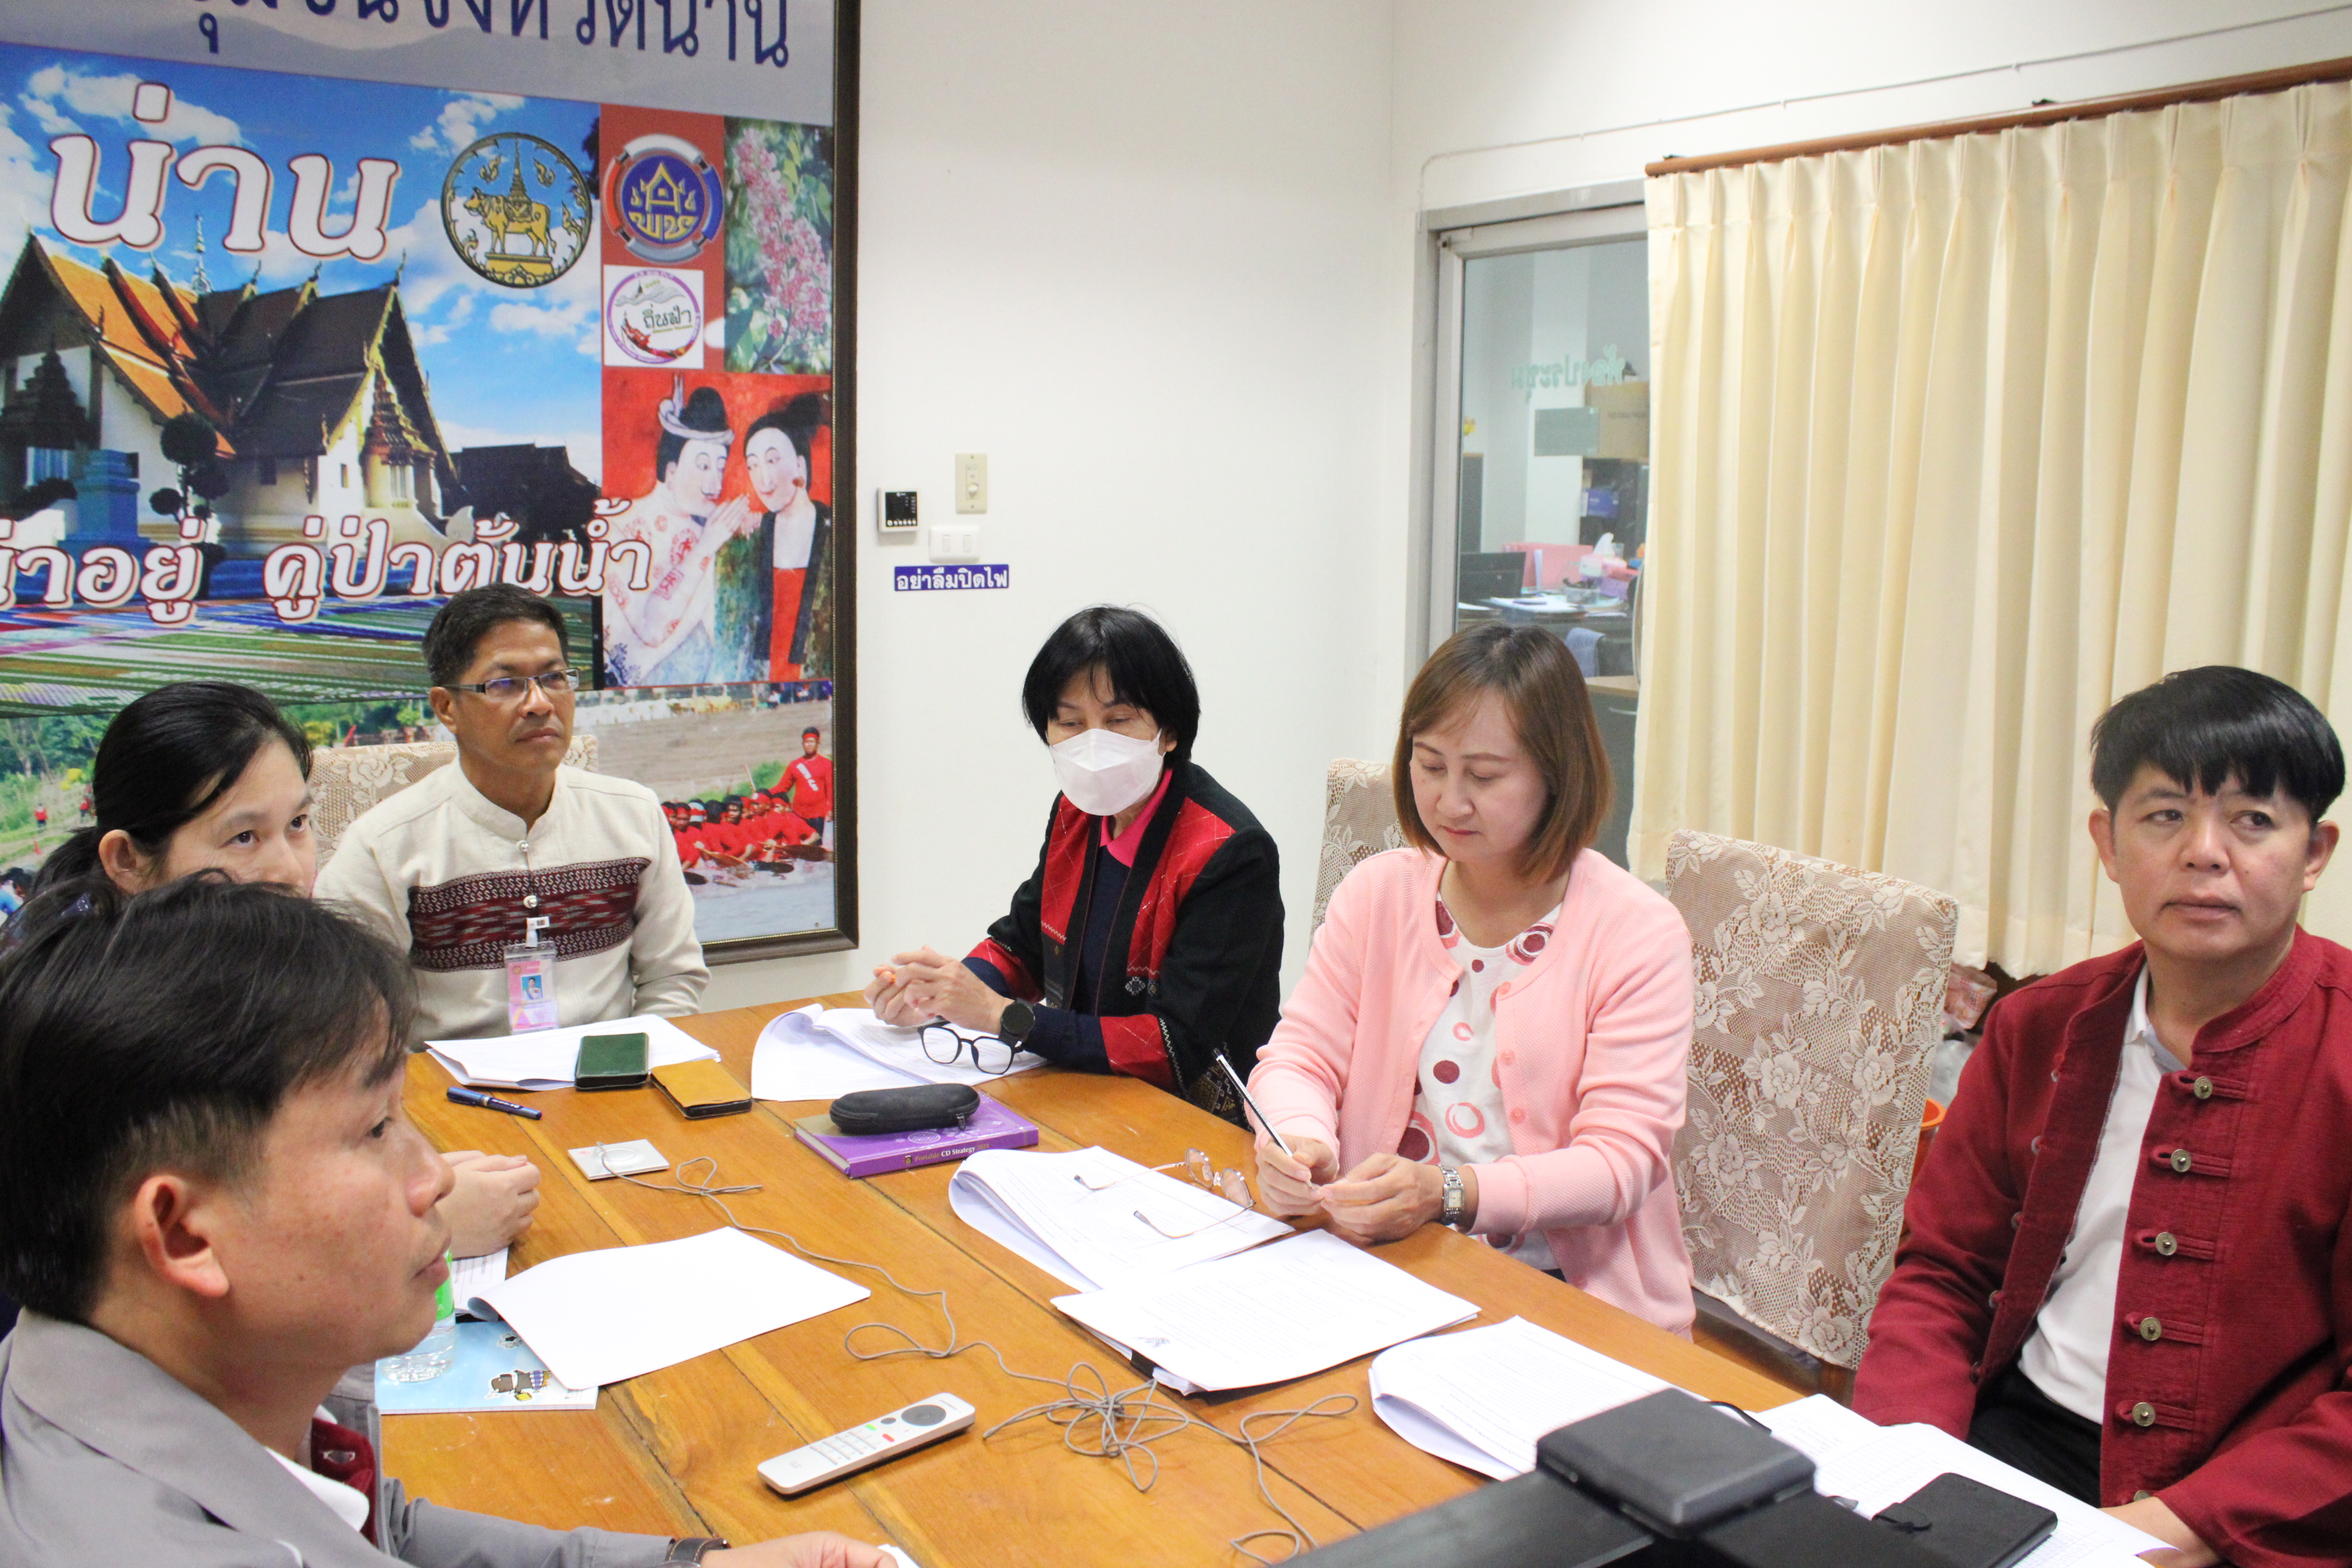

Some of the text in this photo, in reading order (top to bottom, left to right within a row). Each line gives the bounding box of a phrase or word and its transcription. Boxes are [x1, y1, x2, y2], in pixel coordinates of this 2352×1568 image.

[50, 81, 400, 262] น่าน
[263, 499, 651, 621] คู่ป่าต้นน้ำ
[896, 566, 1008, 589] อย่าลืมปิดไฟ
[915, 1152, 940, 1162] Portable
[952, 1146, 976, 1155] Strategy
